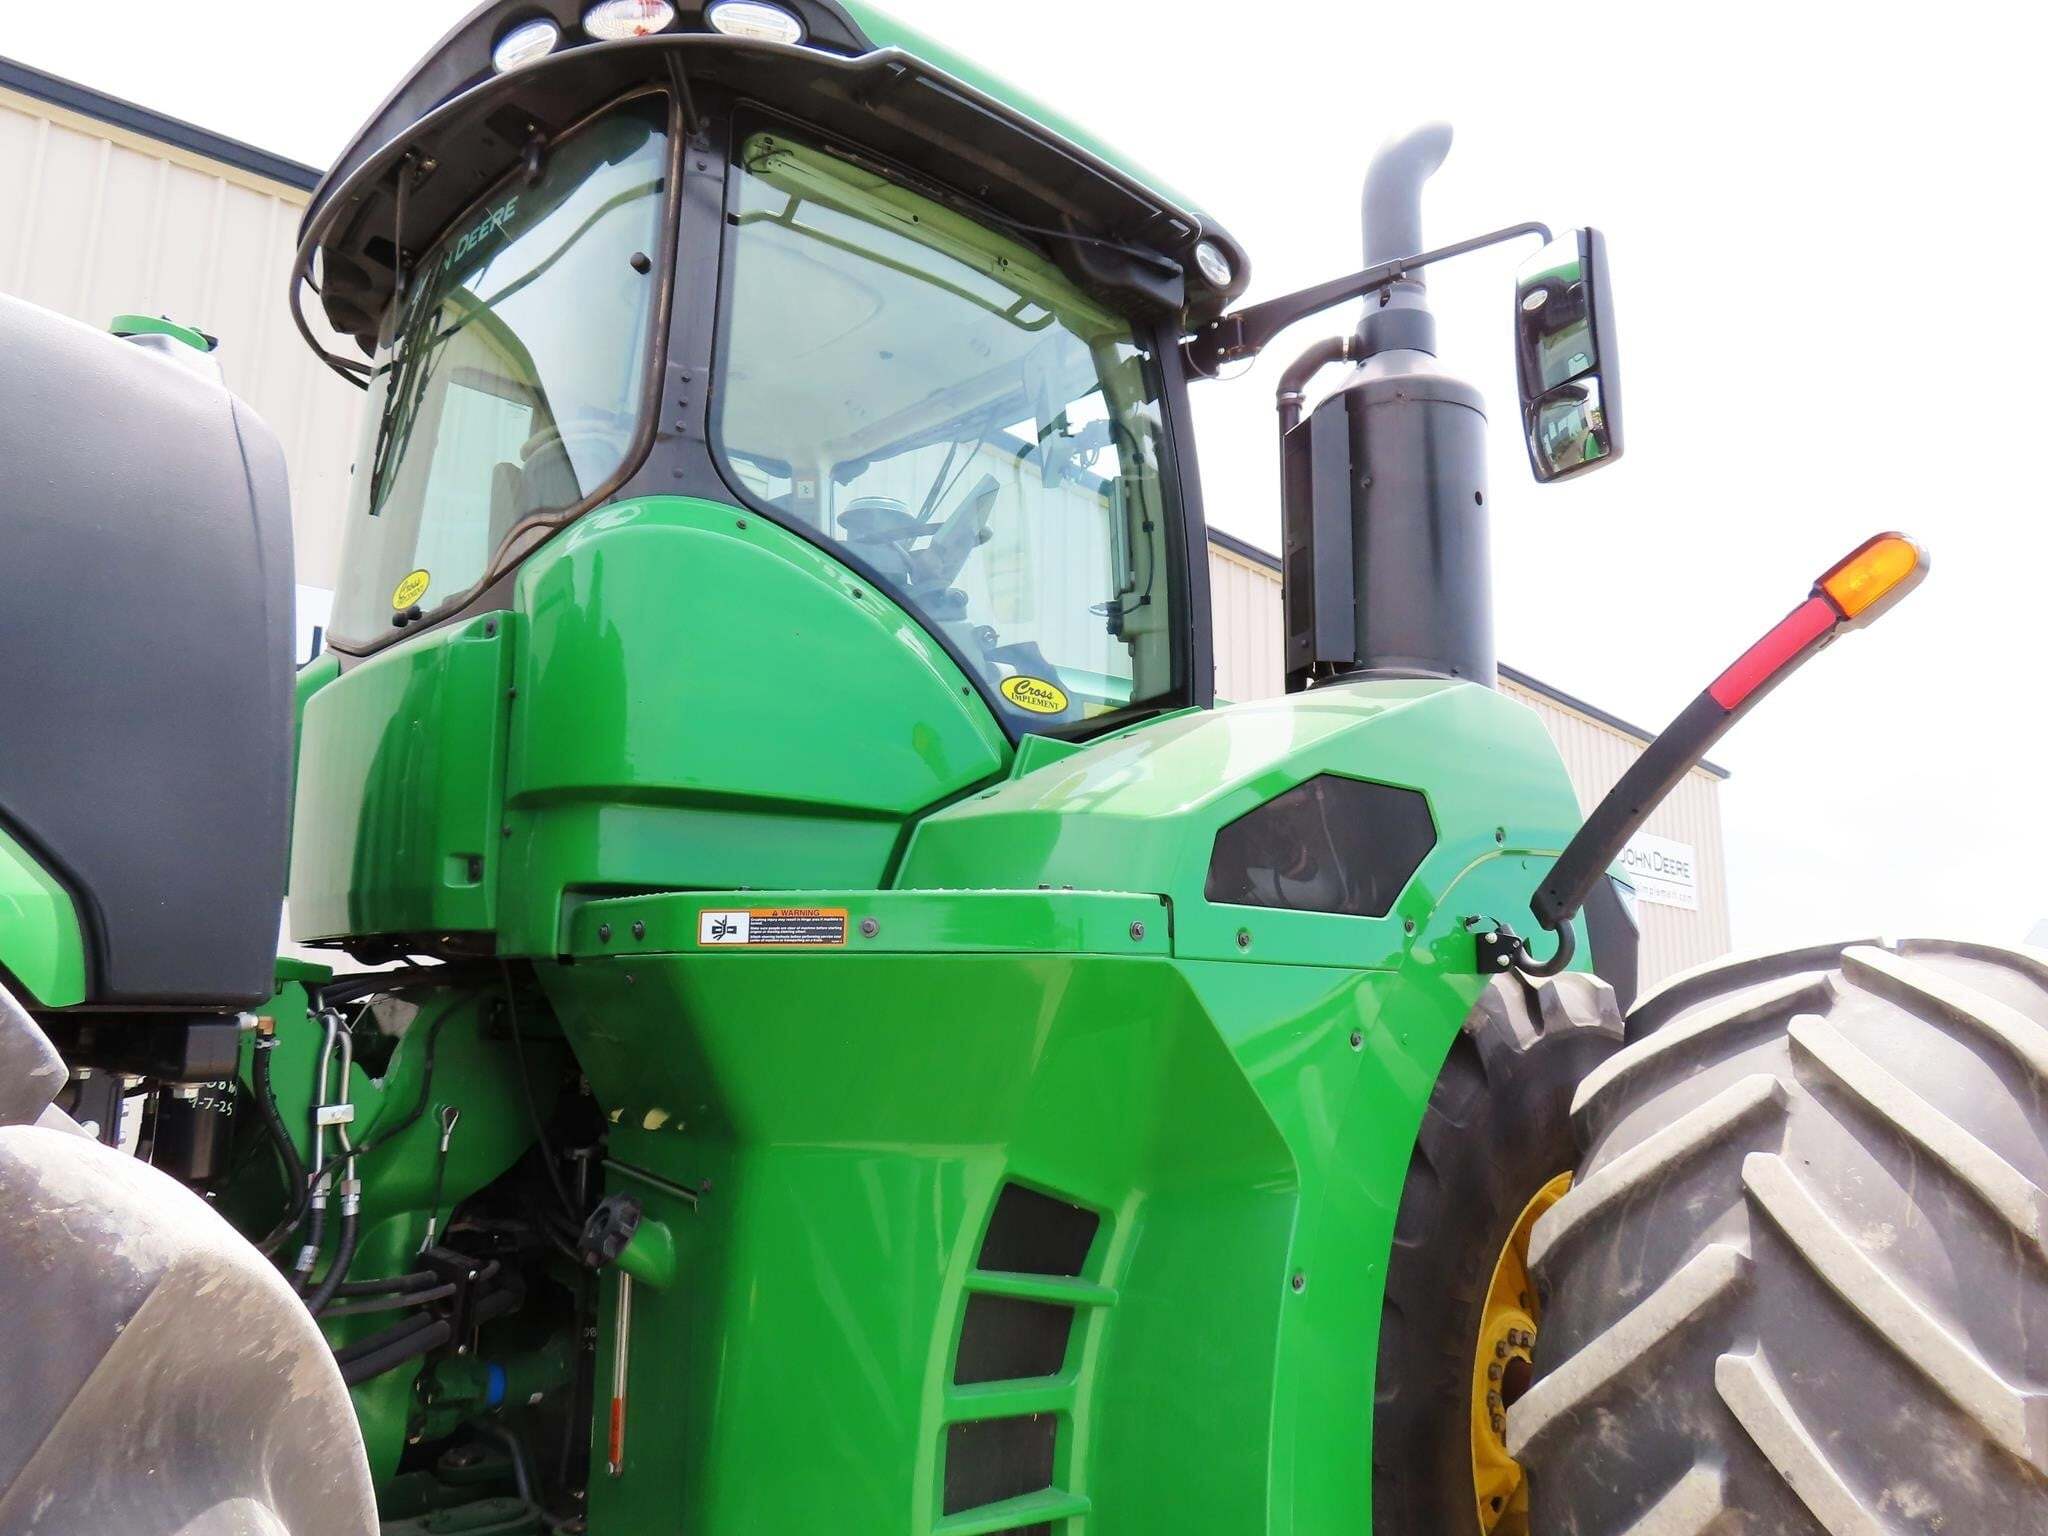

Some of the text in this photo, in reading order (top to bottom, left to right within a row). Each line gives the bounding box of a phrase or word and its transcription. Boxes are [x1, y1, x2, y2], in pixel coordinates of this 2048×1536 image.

[455, 195, 519, 262] DEERE
[1013, 679, 1053, 700] Cross
[1011, 692, 1059, 710] IMPLEMENT
[1653, 850, 1691, 879] DEERE
[781, 909, 820, 917] WARNING
